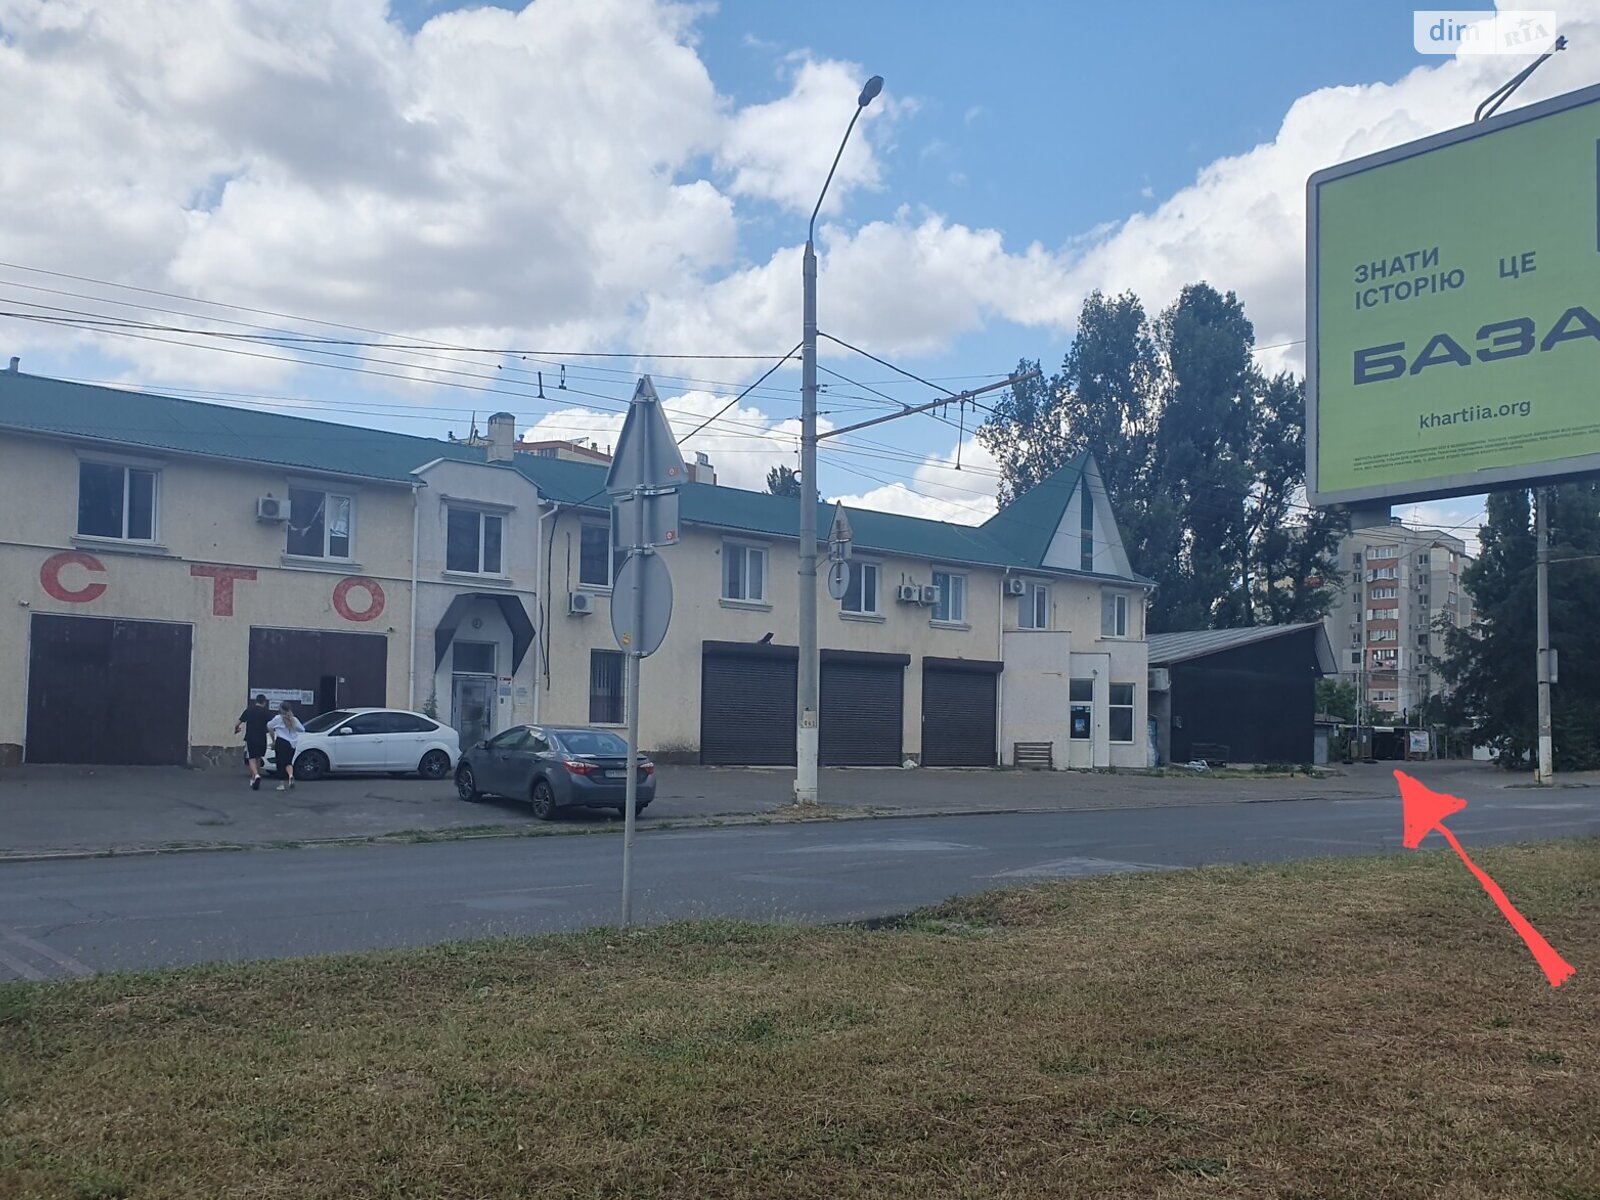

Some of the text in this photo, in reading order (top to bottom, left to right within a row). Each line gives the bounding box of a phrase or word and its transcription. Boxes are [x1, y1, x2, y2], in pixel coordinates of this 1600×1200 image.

[1354, 246, 1440, 285] ЗНАТИ
[1354, 251, 1537, 310] ІСТОРІЮ ЦЕ
[1354, 306, 1600, 385] БАЗА
[1419, 399, 1532, 430] khartiia.org
[40, 551, 386, 622] СТО
